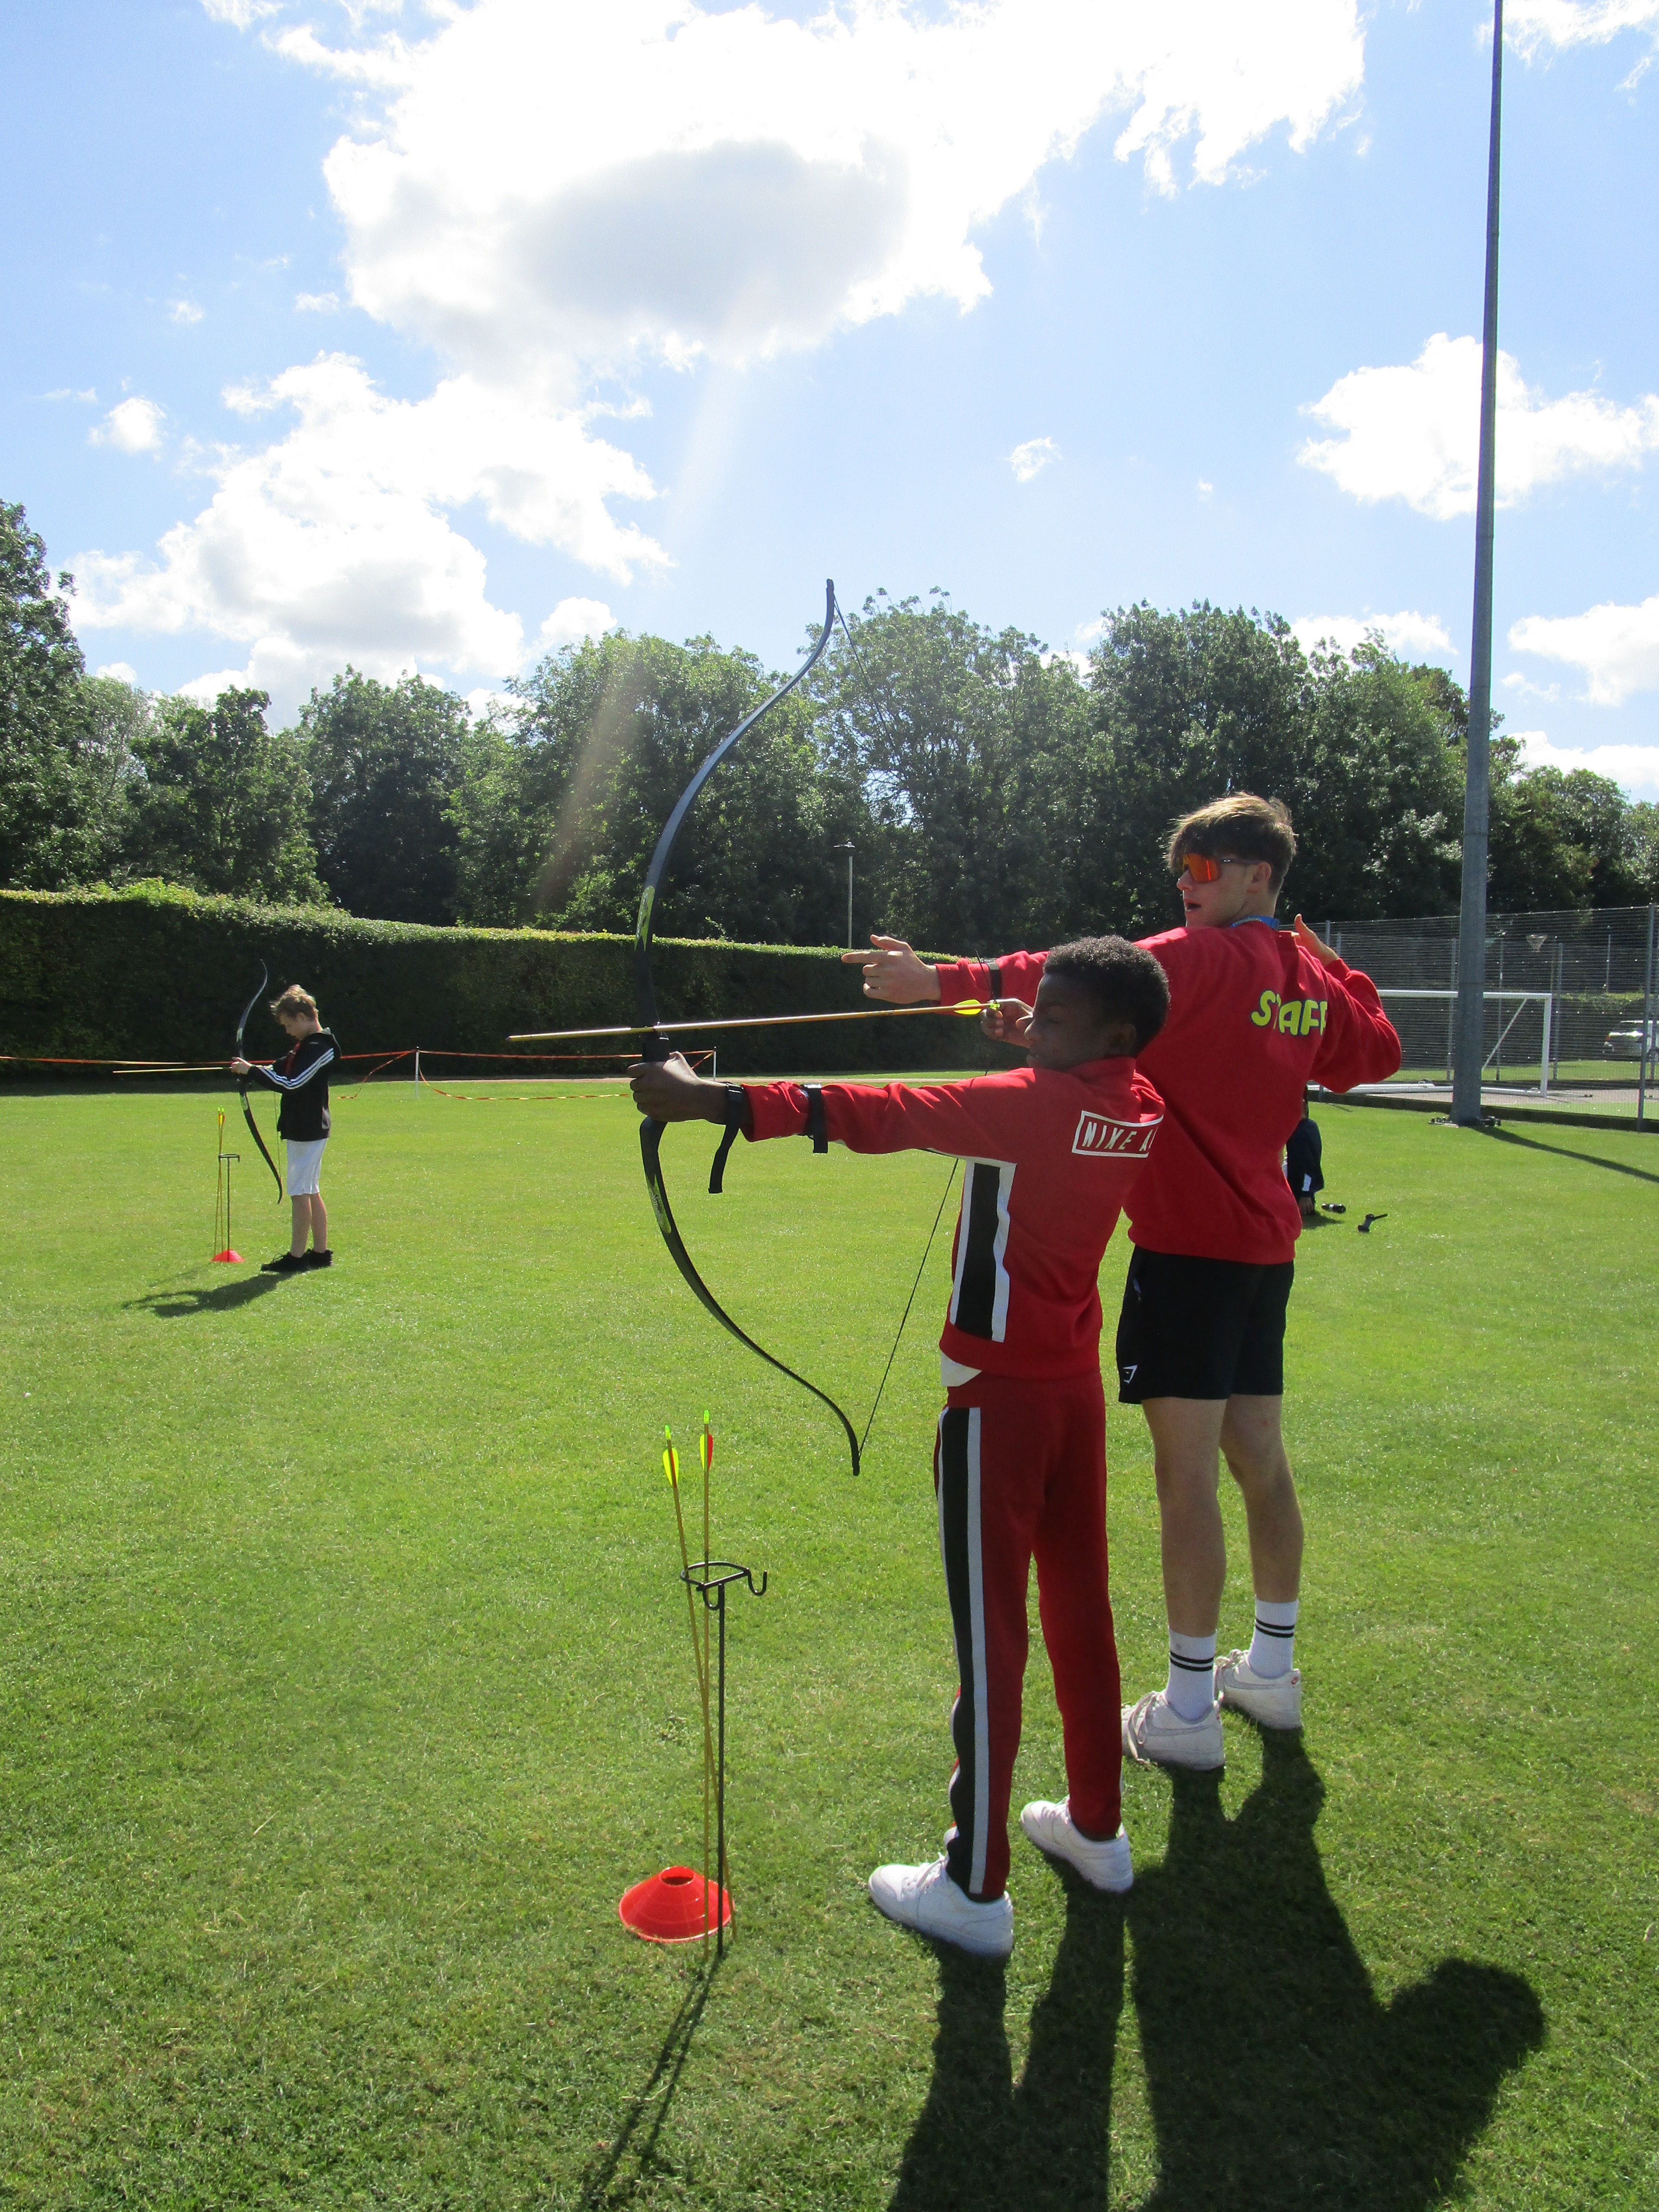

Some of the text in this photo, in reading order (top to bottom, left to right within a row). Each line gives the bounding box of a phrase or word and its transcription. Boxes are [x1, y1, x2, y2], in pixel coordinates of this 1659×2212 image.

[1251, 990, 1328, 1036] SAFF
[1082, 1121, 1158, 1152] NIKE A
